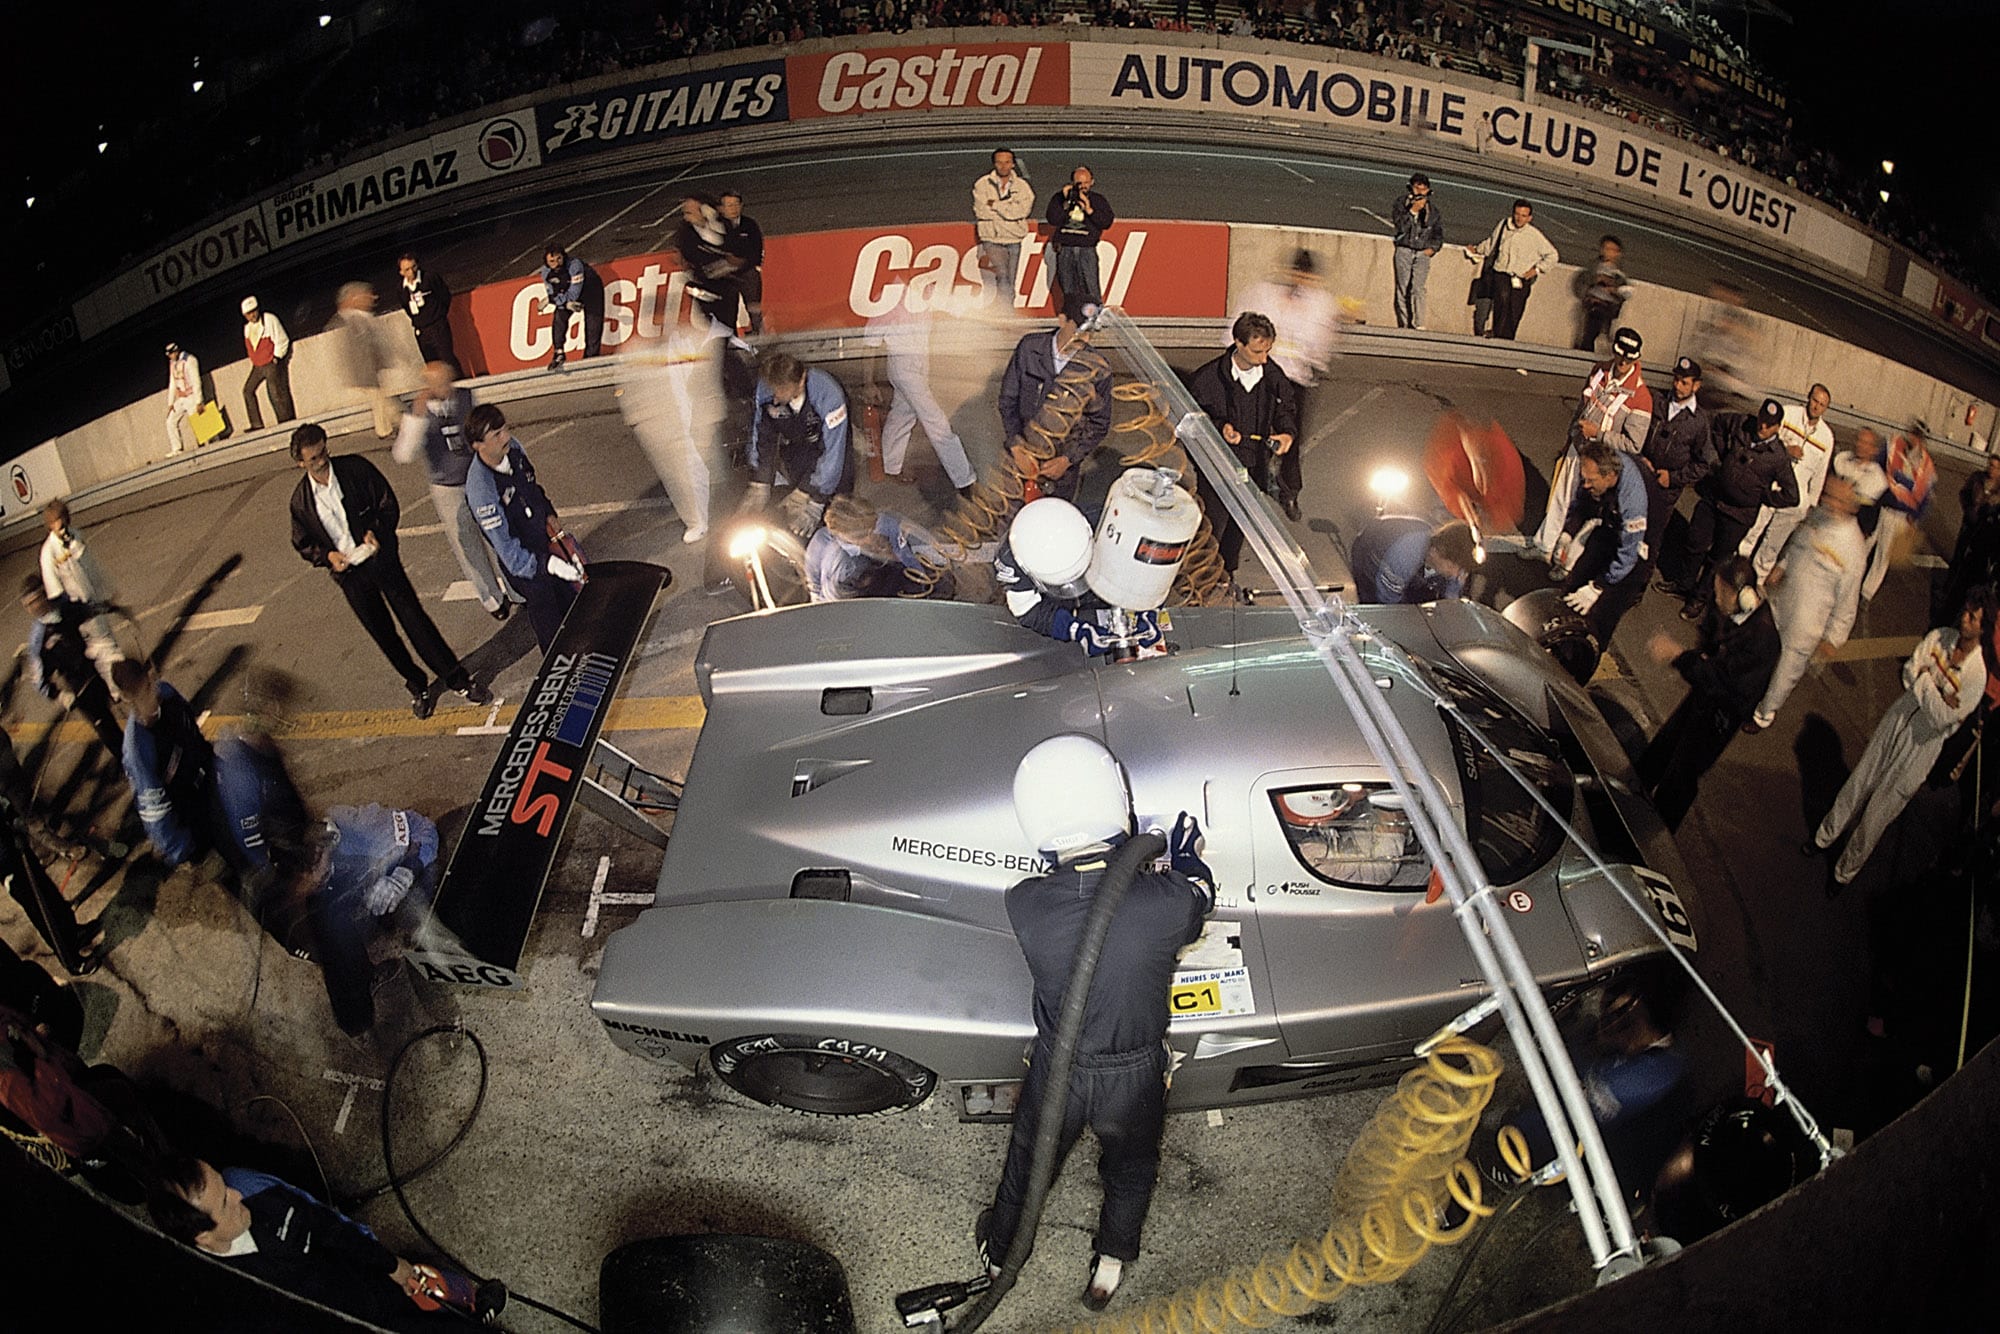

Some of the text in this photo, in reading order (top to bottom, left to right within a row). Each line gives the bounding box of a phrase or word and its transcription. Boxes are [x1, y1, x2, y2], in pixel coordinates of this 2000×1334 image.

[817, 47, 1043, 113] Castrol
[1690, 48, 1786, 110] MICHELIN
[598, 74, 782, 140] GITANES
[1111, 54, 1796, 234] AUTOMOBILE CLUB DE L'OUEST
[276, 150, 459, 239] PRIMAGAZ
[144, 218, 267, 294] TOYOTA
[1106, 523, 1122, 546] 61
[477, 653, 577, 836] MERCEDES-BENZ
[511, 741, 573, 838] ST
[396, 813, 409, 844] AEG
[891, 836, 1055, 874] MERCEDES-BENZ
[1513, 895, 1527, 908] E
[422, 962, 513, 987] AEG
[1172, 988, 1214, 1010] C1
[1181, 975, 1207, 984] HEURES
[1224, 969, 1245, 977] MANS
[603, 1018, 710, 1045] MICHELIN
